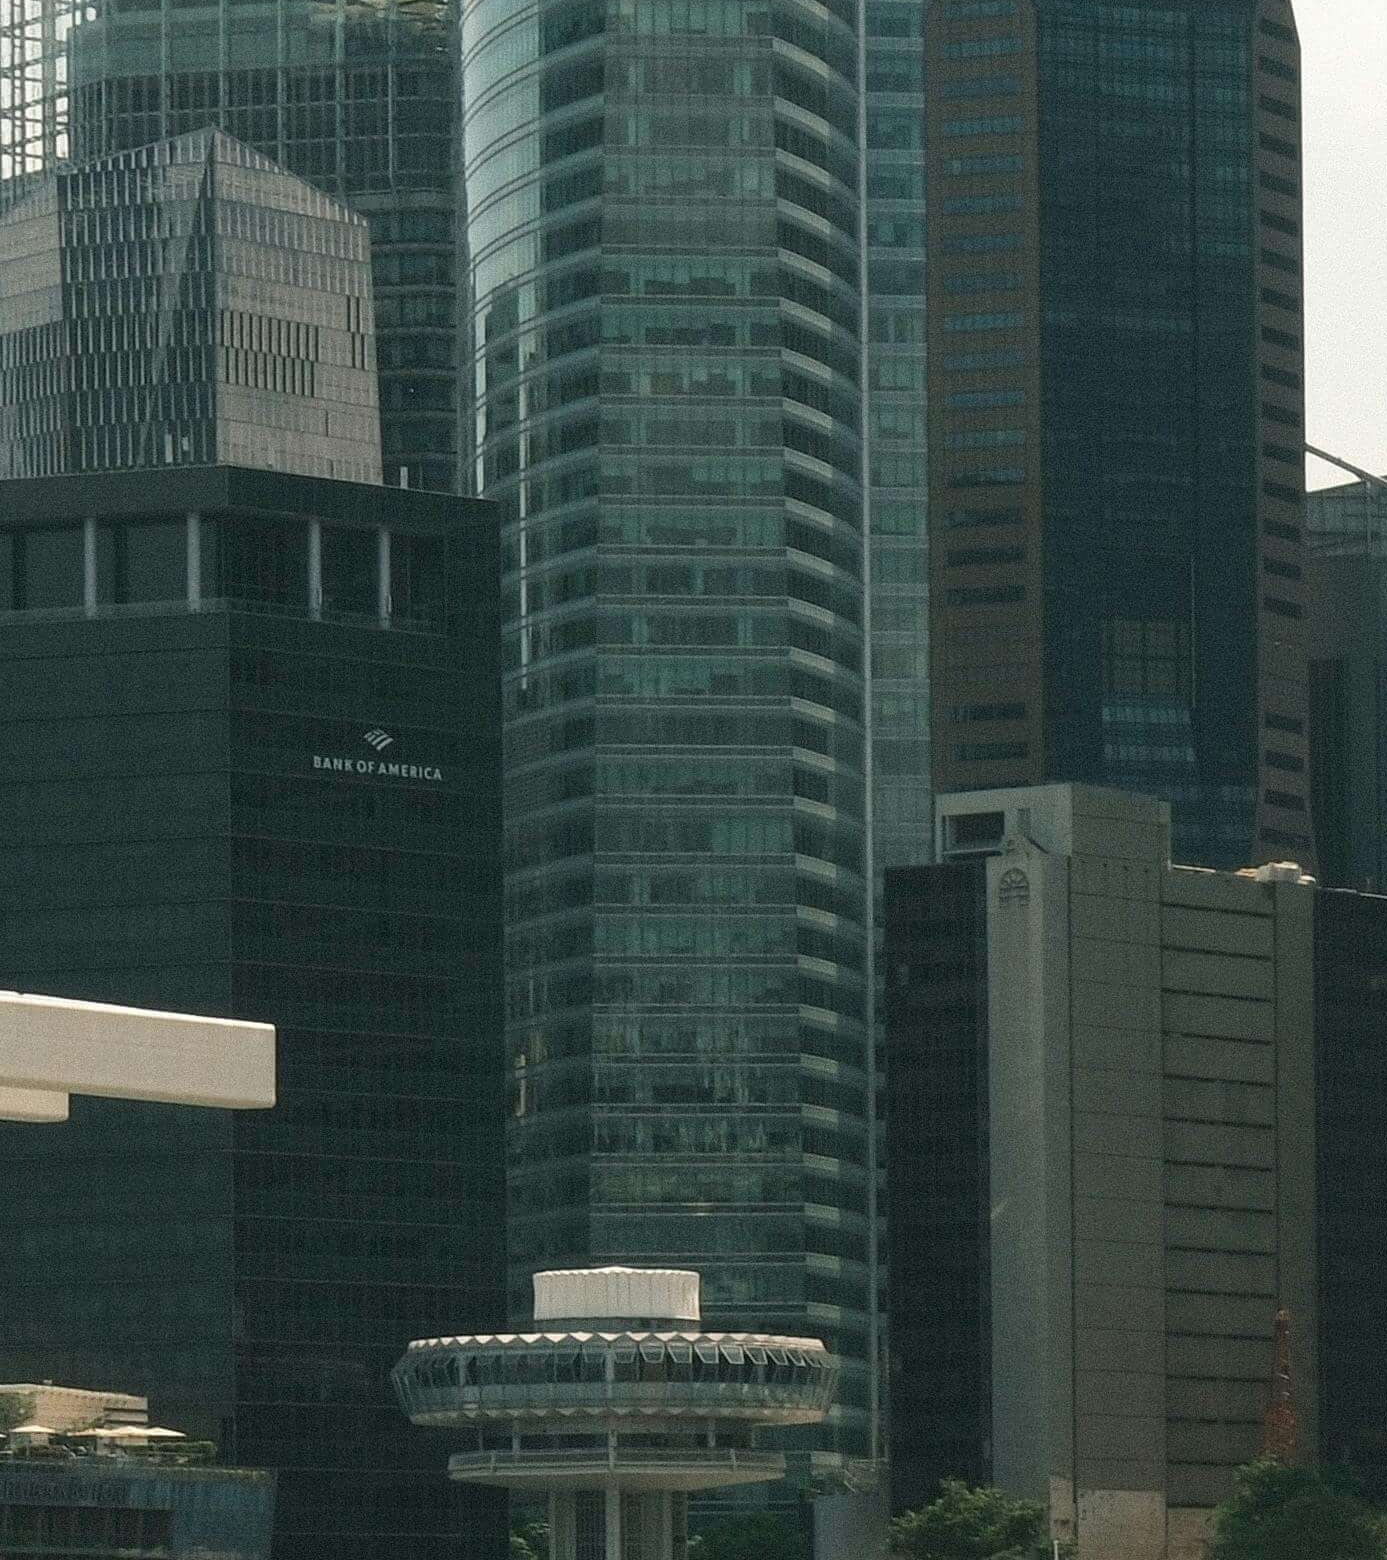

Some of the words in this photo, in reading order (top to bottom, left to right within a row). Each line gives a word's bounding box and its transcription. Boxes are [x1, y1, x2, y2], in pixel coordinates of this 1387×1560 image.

[313, 756, 354, 772] BANK
[356, 760, 376, 774] OF
[378, 762, 442, 781] AMERICA
